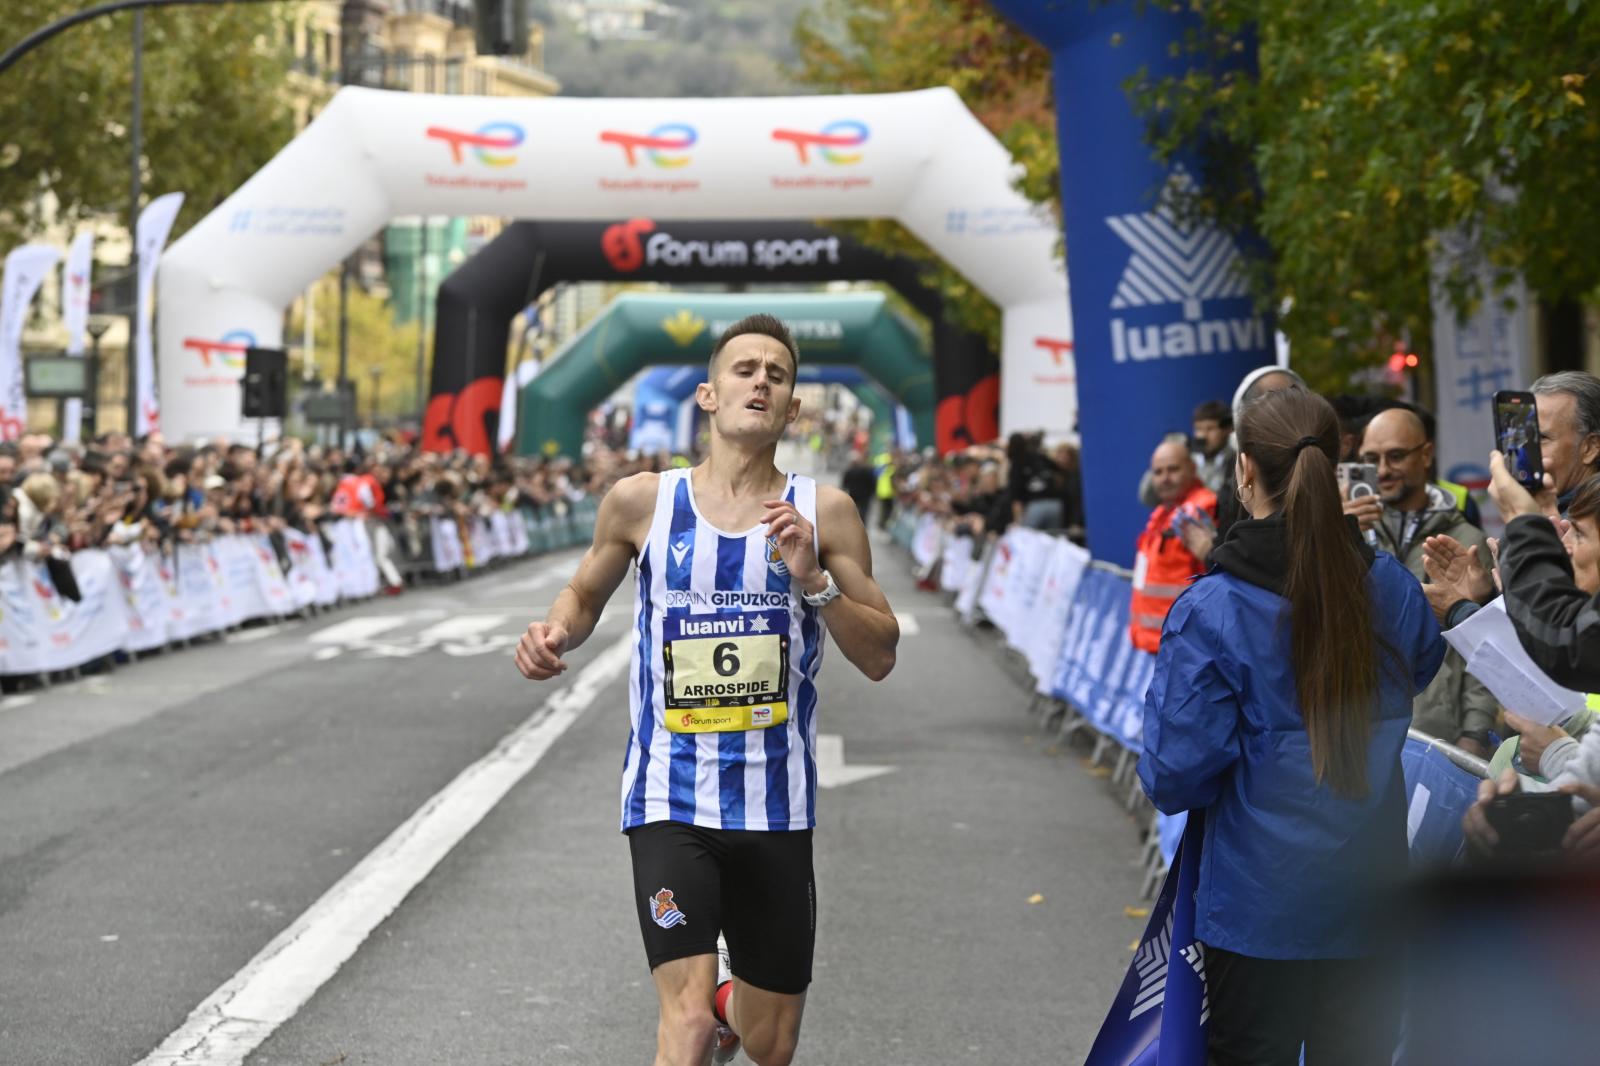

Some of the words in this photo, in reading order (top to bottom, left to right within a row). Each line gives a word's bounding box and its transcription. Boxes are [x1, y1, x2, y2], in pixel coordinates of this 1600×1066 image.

[753, 236, 840, 270] sport
[1110, 319, 1265, 364] luanvi
[666, 592, 707, 606] ORAIN
[711, 592, 791, 608] GIPUZKOA
[680, 615, 745, 635] luanvi
[713, 642, 740, 677] 6
[683, 680, 769, 696] ARROSPIDE
[713, 717, 731, 726] sport
